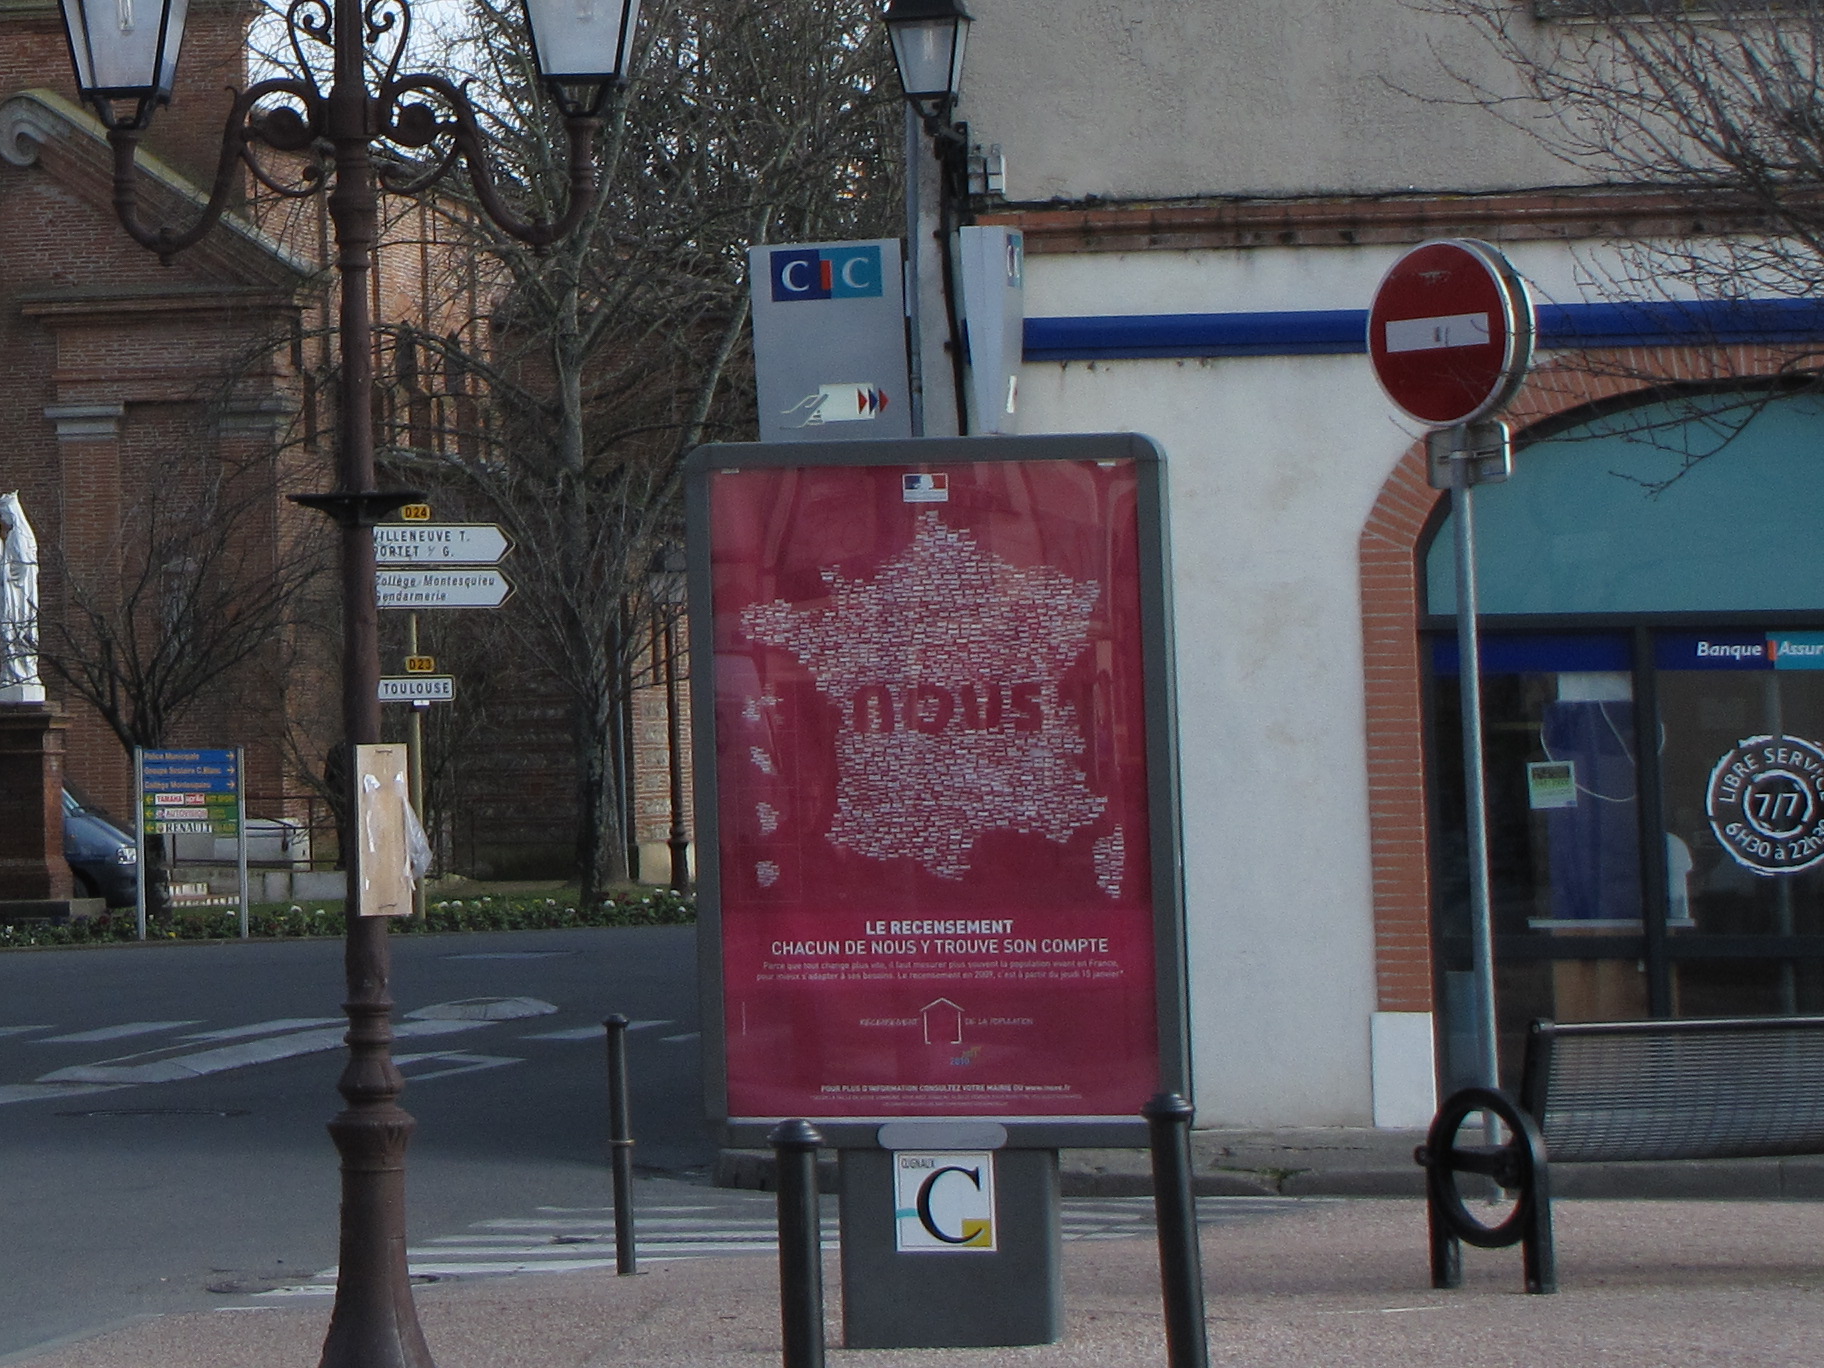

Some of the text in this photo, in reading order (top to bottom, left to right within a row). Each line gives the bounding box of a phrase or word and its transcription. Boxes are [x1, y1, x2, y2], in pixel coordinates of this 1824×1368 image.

[781, 256, 871, 293] CIC
[405, 506, 428, 519] D24
[373, 530, 470, 542] VILLENEUVE T.
[423, 574, 495, 589] Montesquieu
[376, 589, 447, 602] Gendarmerie
[1697, 641, 1762, 660] Banque
[384, 682, 450, 695] TOULOUSE
[1719, 753, 1759, 803] LIBRE
[1754, 793, 1799, 820] 7/7
[165, 822, 211, 833] RENAULT
[1725, 822, 1771, 858] 6H30
[1774, 843, 1785, 860] à
[865, 920, 1014, 934] LE RECENSEMENT
[771, 938, 1108, 955] CHACUN DE NOUS Y TROUVE SON COMPTE
[916, 1165, 984, 1244] C
